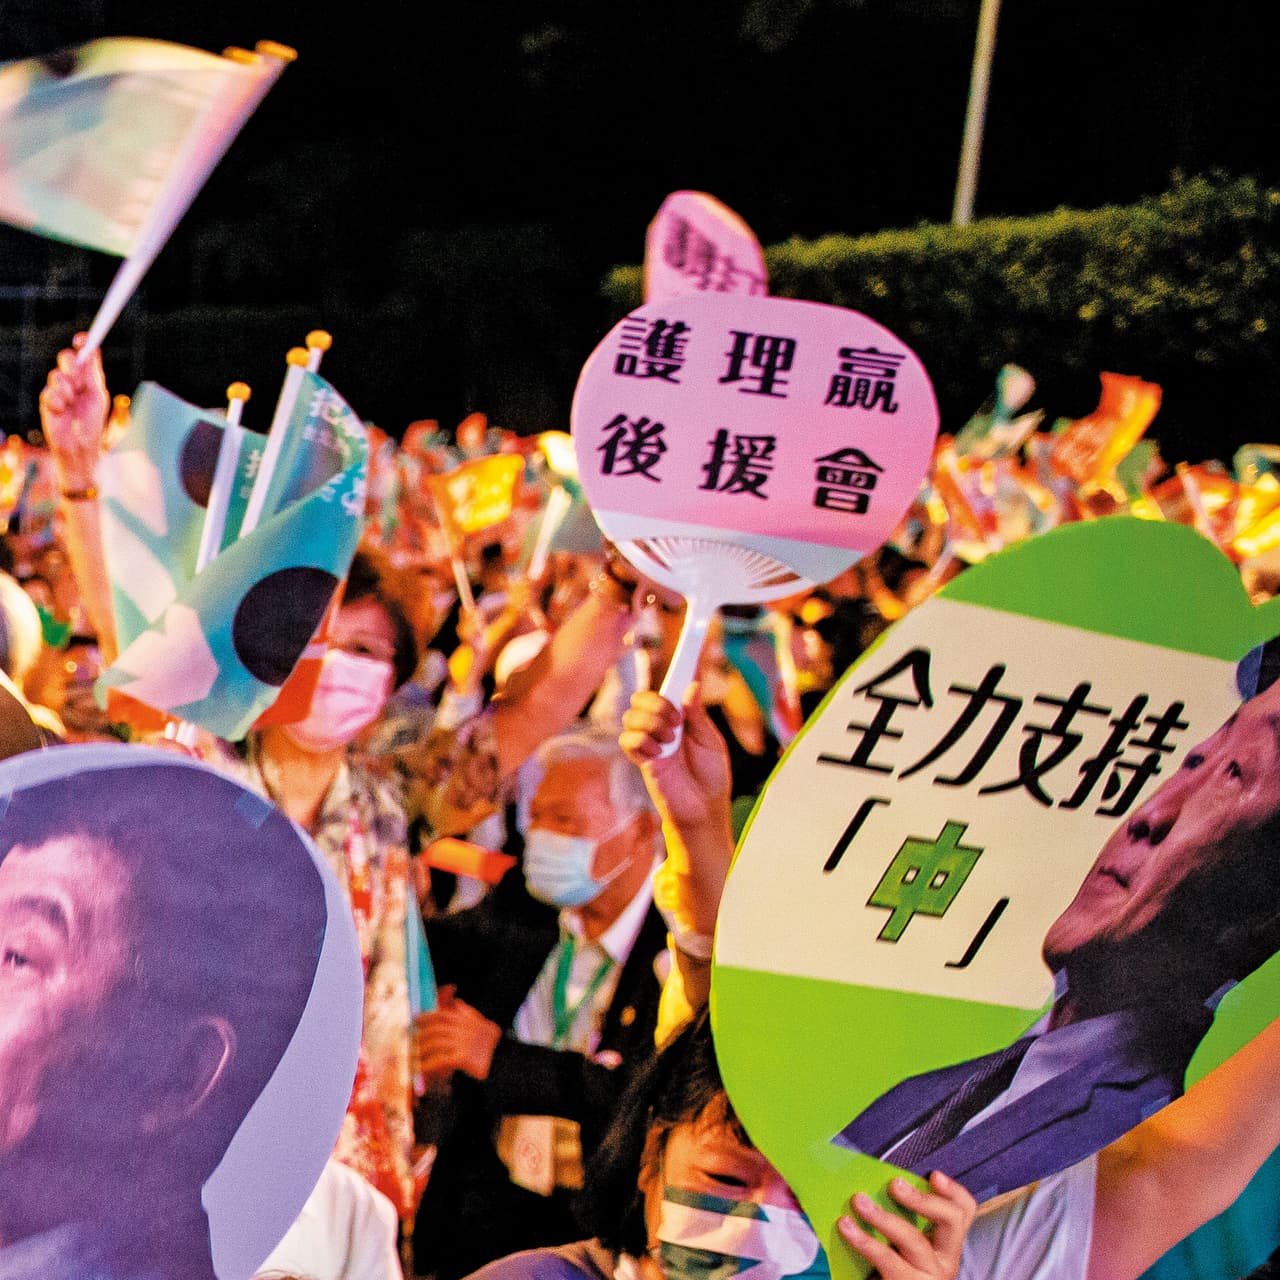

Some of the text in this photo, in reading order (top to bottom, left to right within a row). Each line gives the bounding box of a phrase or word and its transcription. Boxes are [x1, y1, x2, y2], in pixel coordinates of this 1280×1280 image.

[613, 316, 907, 414] 護理贏
[596, 412, 886, 515] 後援會
[816, 648, 1190, 819] 全力支持
